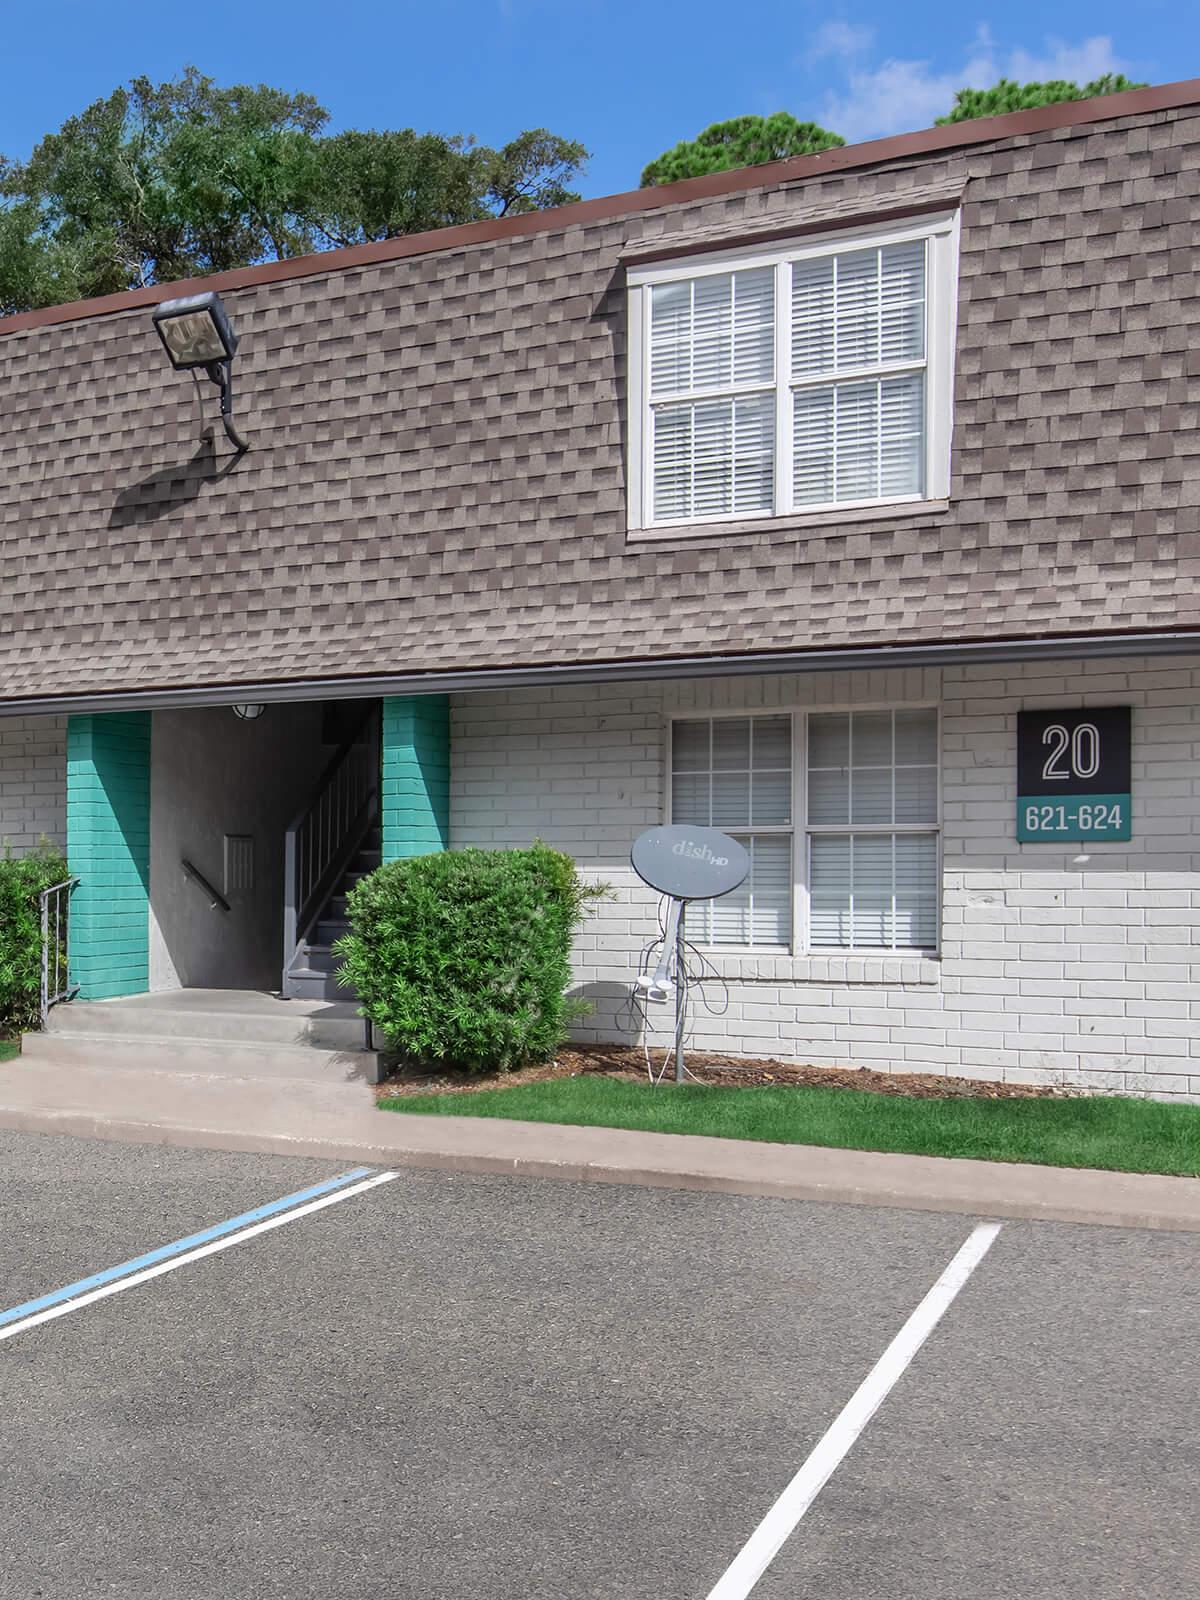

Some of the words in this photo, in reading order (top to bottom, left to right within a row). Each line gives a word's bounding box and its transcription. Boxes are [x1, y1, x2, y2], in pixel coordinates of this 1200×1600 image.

[1042, 723, 1100, 780] 20
[1025, 804, 1123, 831] 621-624
[672, 840, 713, 861] dish
[710, 856, 729, 866] HD
